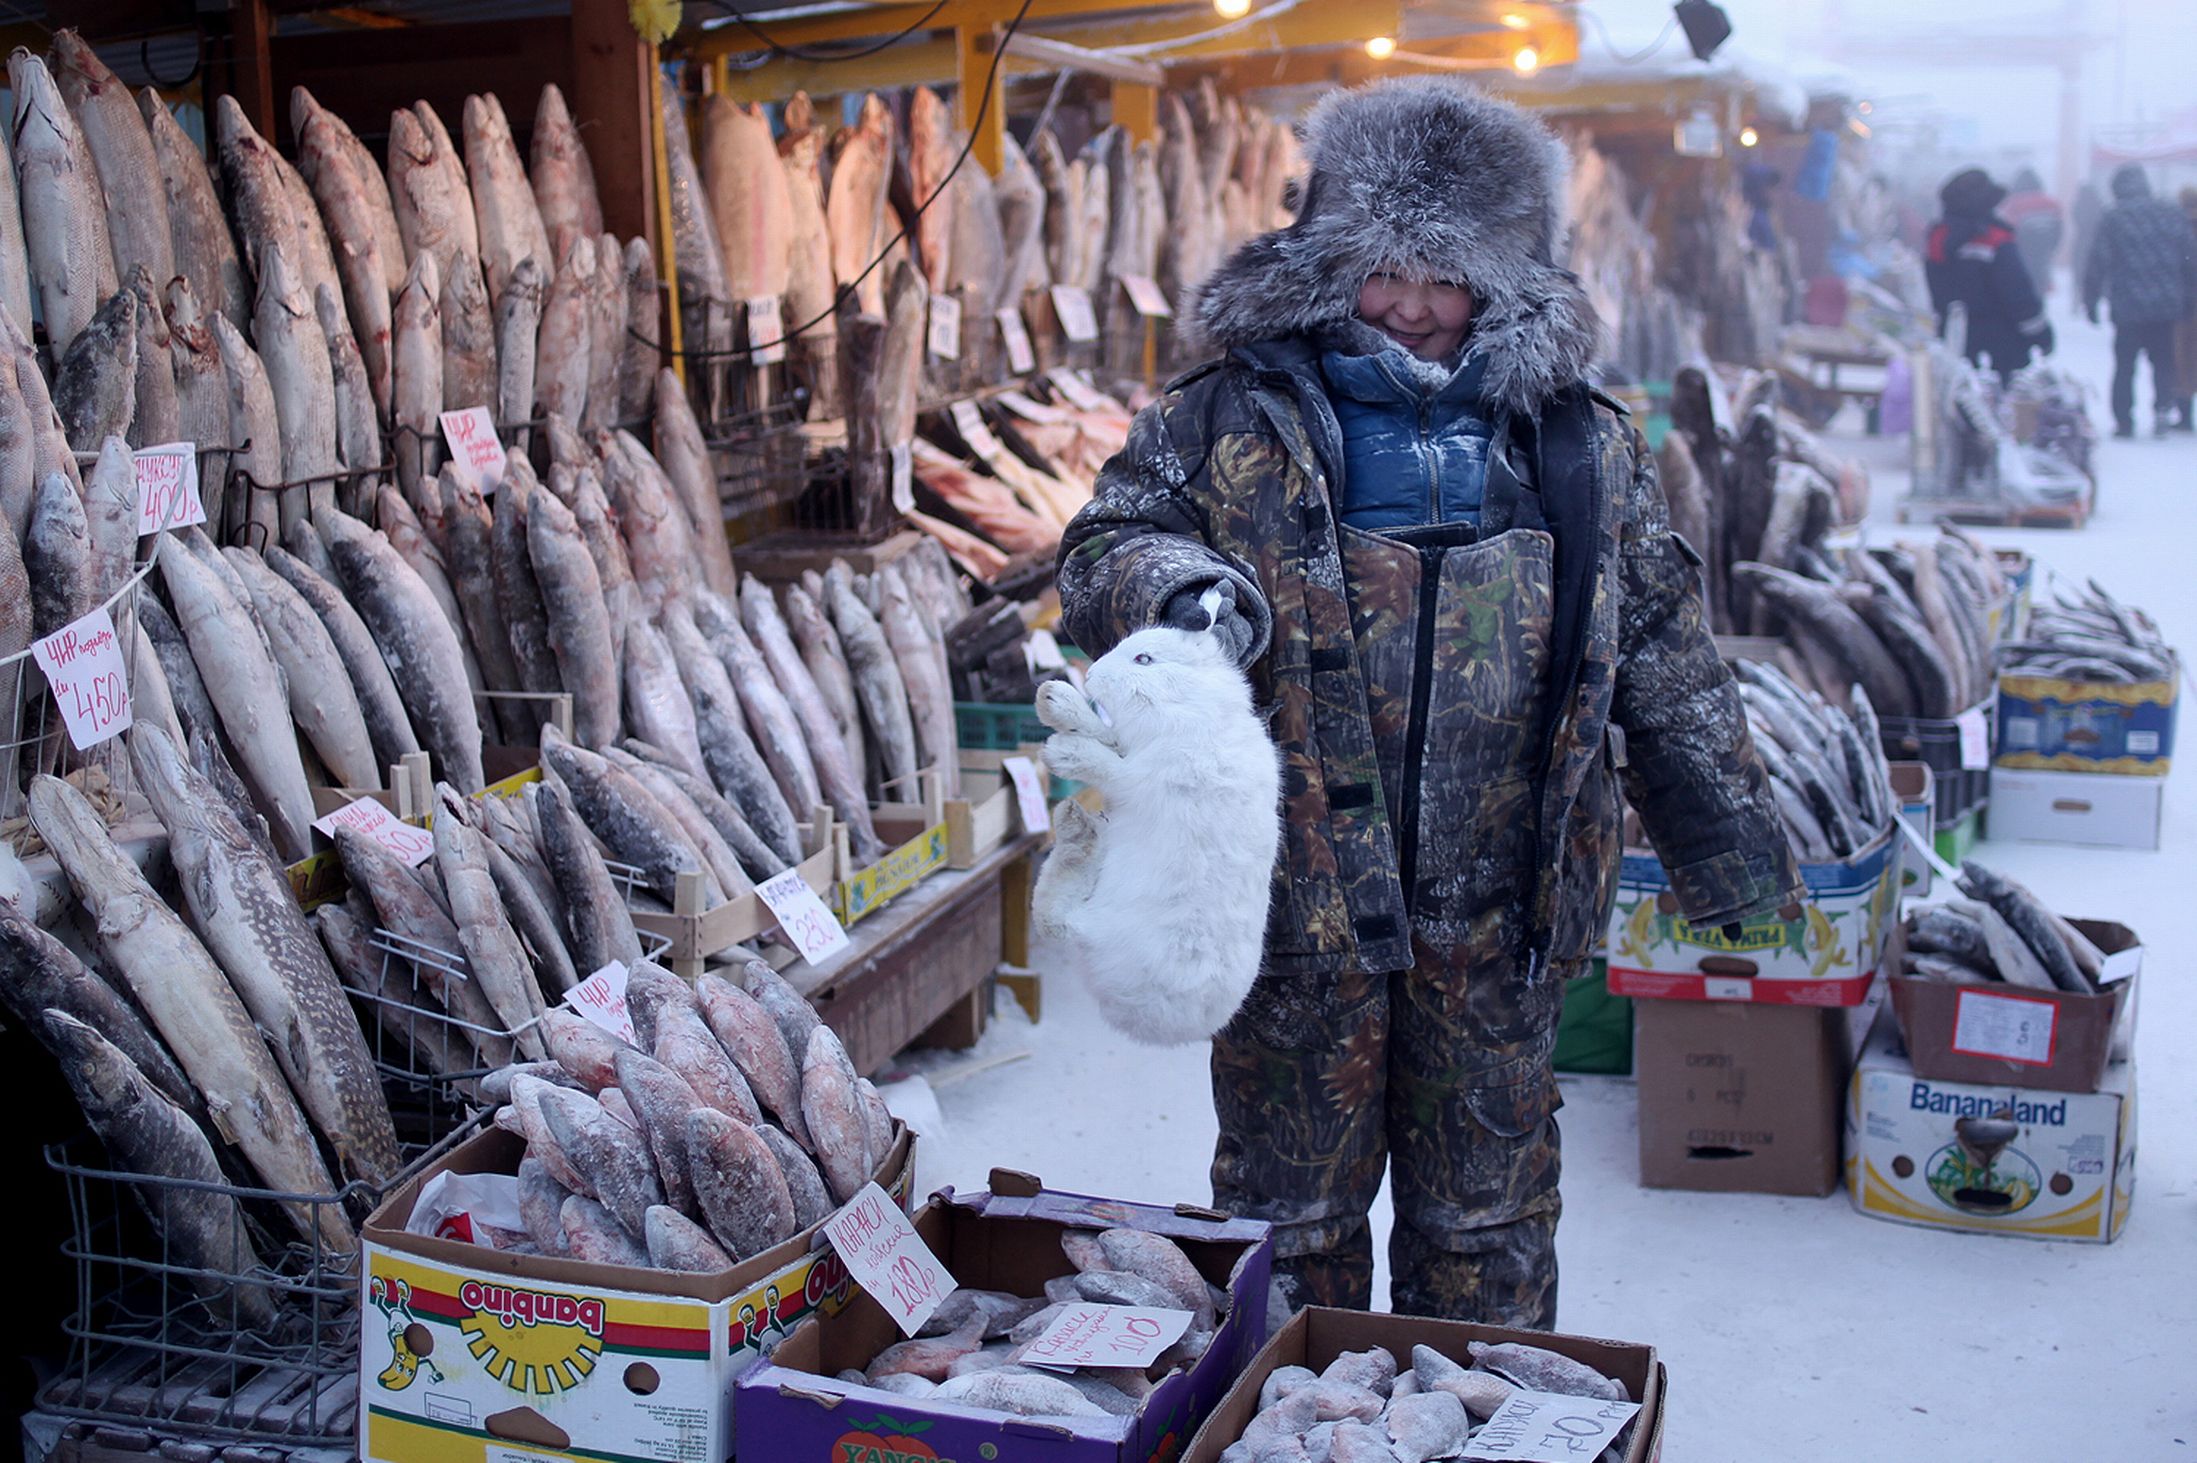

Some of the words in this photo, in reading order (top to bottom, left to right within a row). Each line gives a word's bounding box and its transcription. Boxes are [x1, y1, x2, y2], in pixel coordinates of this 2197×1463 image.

[45, 630, 77, 668] ЧИР
[1729, 926, 1780, 947] PRIM
[576, 976, 610, 1009] ЧИР
[1911, 1083, 2066, 1126] Bananaland
[832, 1195, 891, 1258] КАРАСИ
[461, 1282, 605, 1336] banbino
